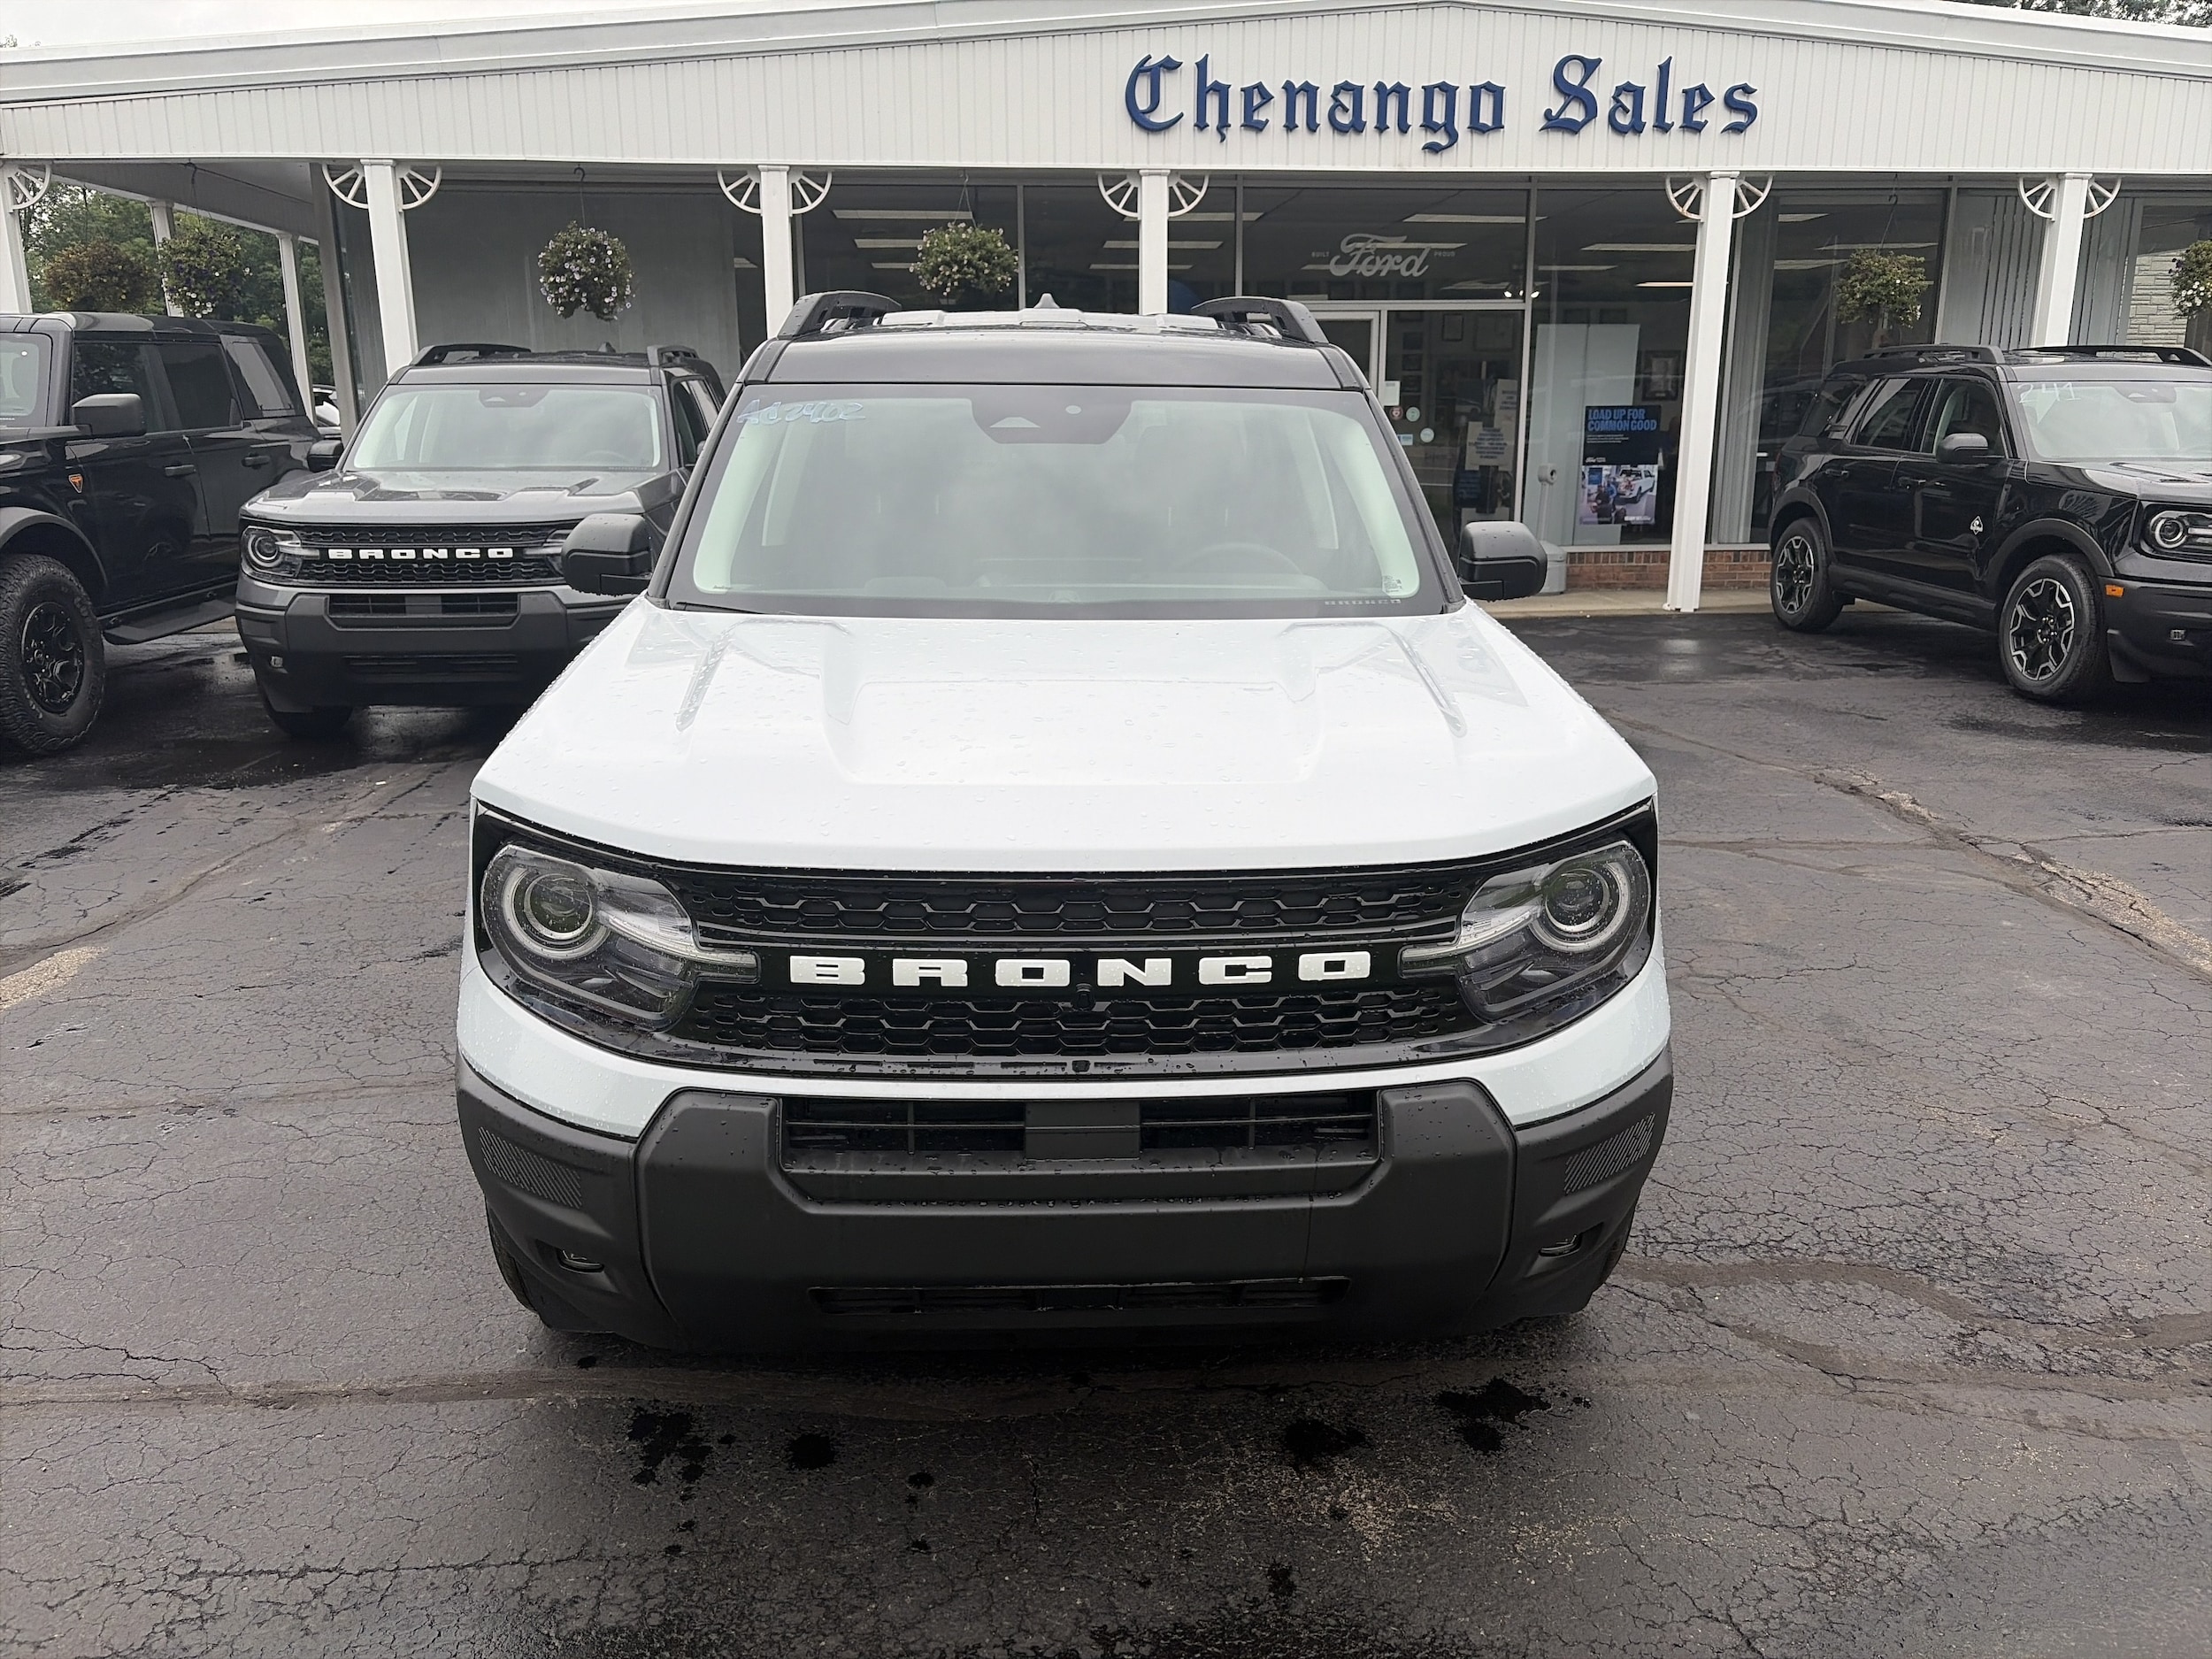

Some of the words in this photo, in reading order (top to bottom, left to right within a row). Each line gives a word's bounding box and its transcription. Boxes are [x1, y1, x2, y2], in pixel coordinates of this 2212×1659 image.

[1125, 53, 1506, 154] Chenango
[1539, 54, 1758, 134] Sales
[1329, 233, 1431, 277] Ford
[1587, 420, 1629, 432] COMMON
[1630, 419, 1657, 431] GOOD
[1588, 409, 1612, 420] LOAD
[1613, 409, 1626, 420] UP
[1627, 408, 1646, 419] FOR
[328, 548, 513, 559] BRONCO
[790, 951, 1371, 987] BRONCO
